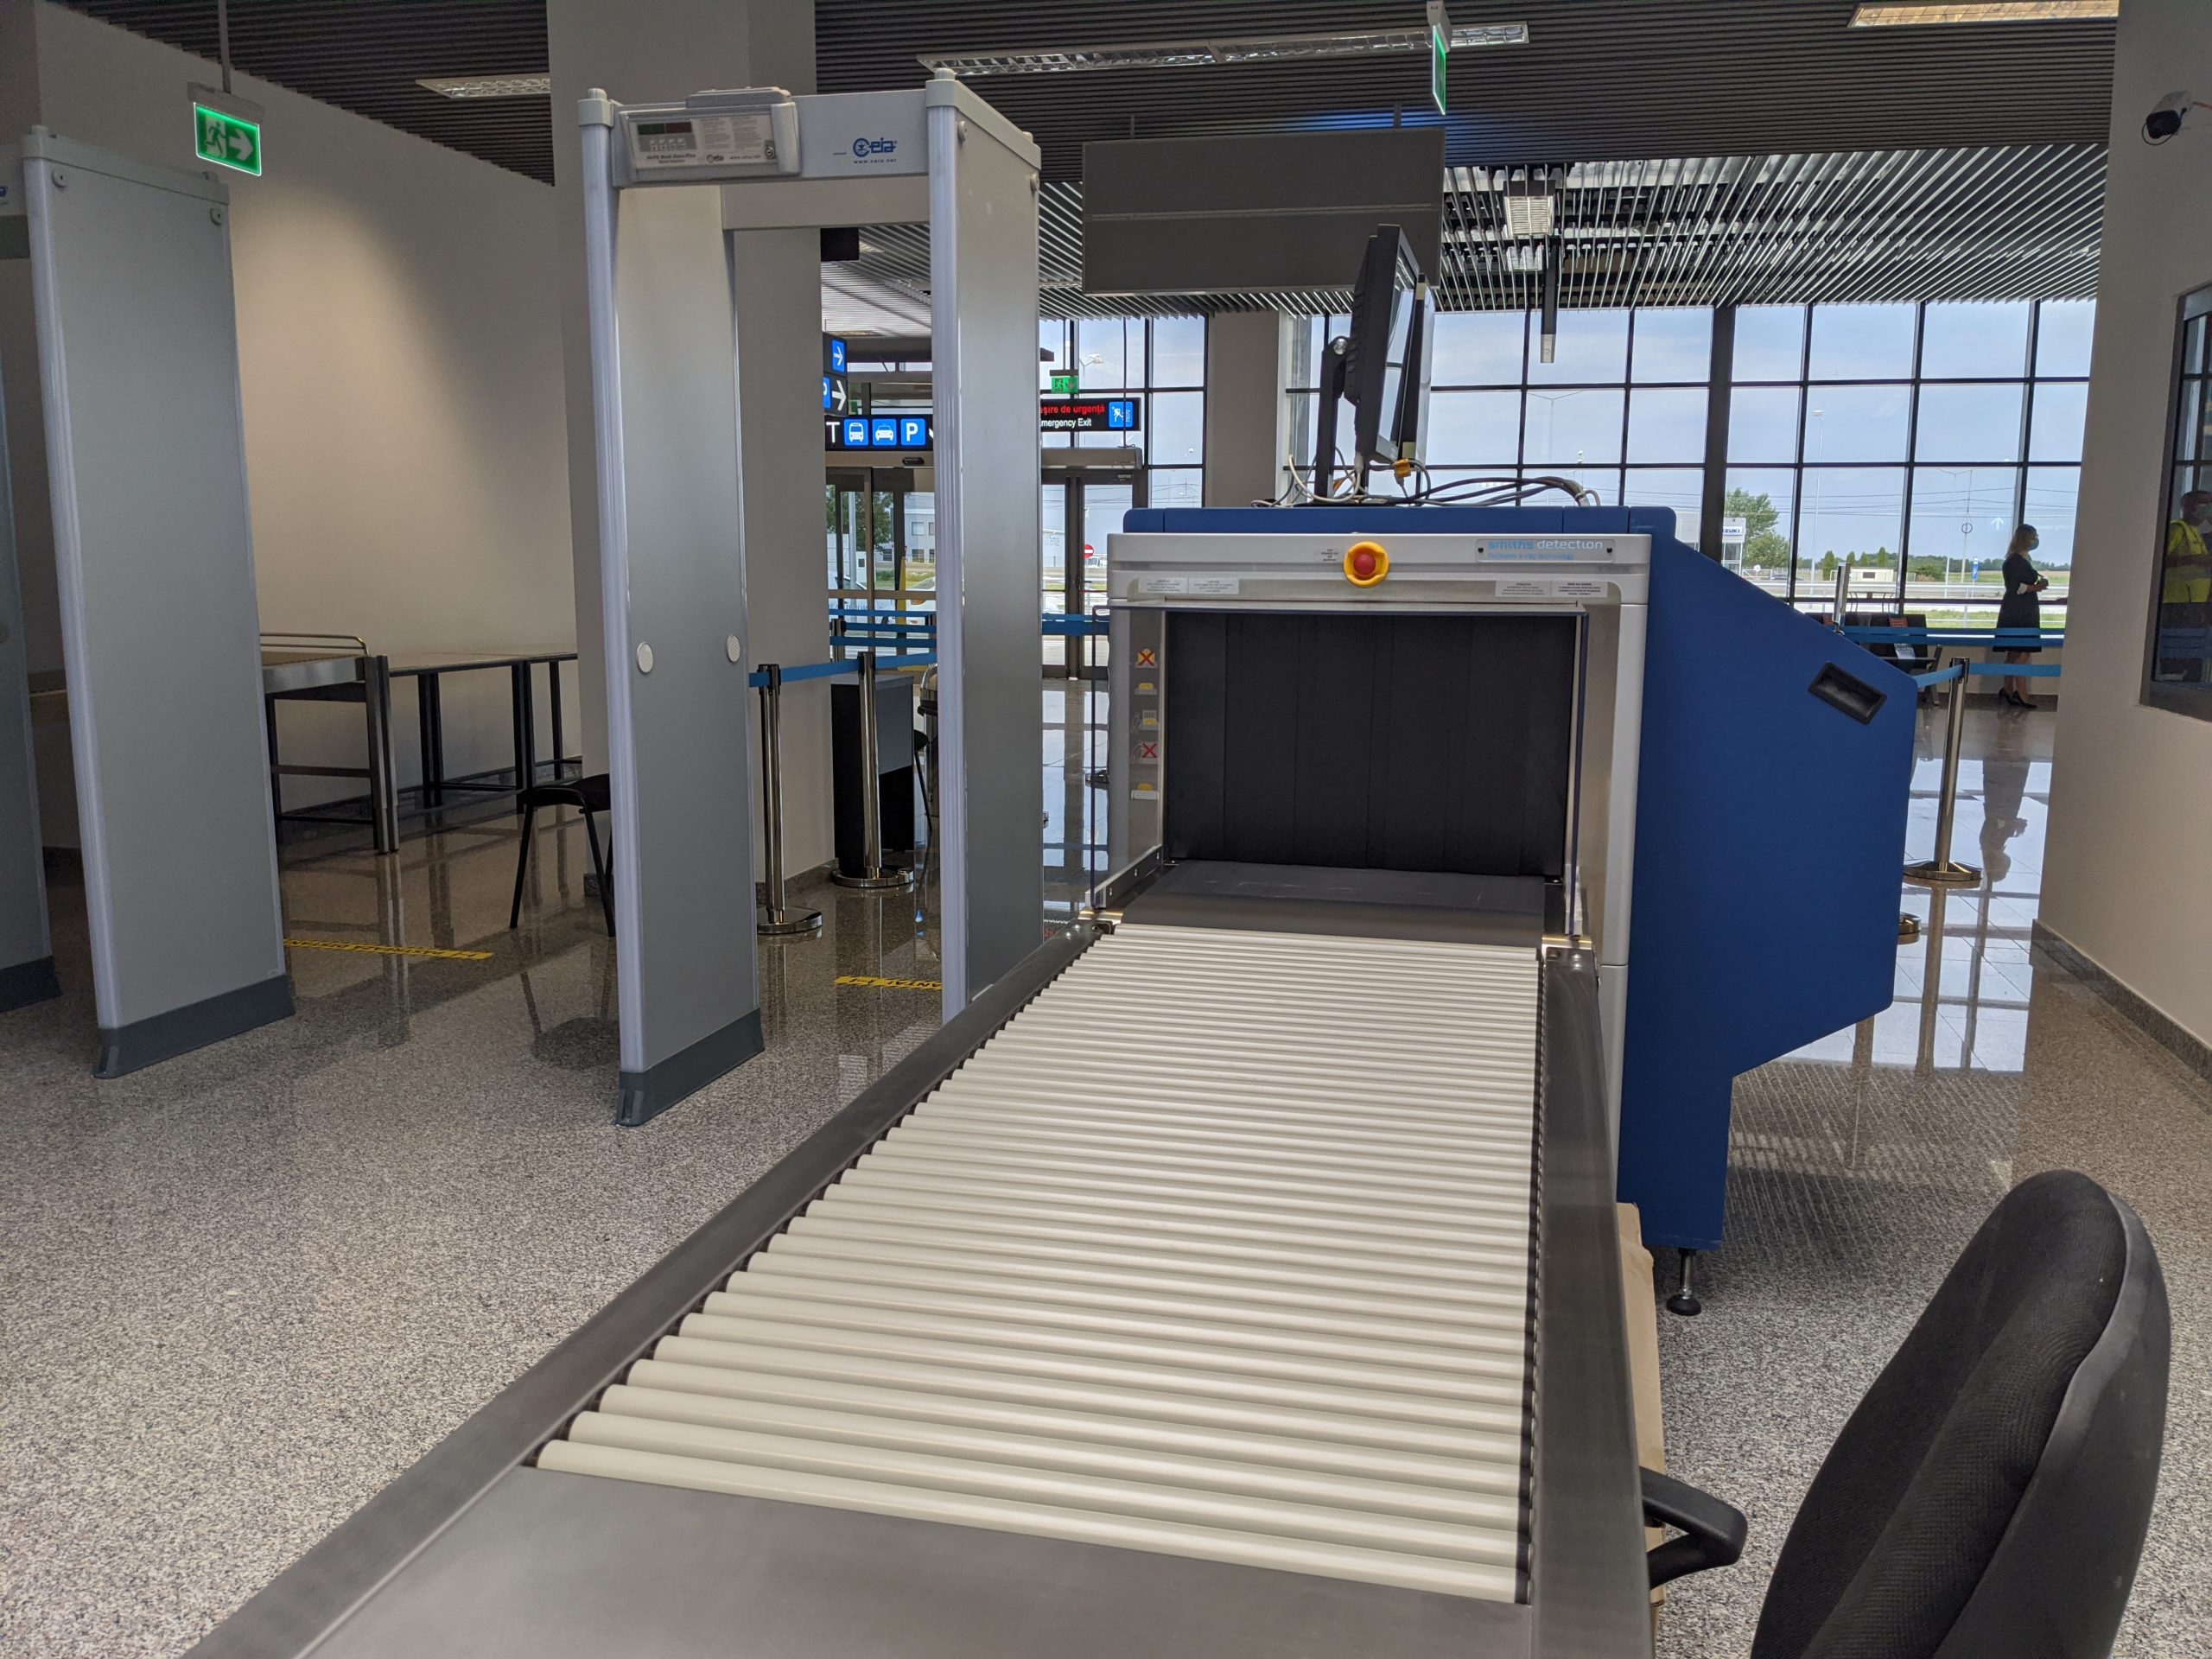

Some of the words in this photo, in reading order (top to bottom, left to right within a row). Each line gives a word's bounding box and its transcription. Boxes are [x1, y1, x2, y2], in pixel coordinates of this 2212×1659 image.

[1060, 404, 1070, 413] de
[1077, 417, 1092, 427] Exit
[906, 422, 918, 442] P
[1487, 540, 1535, 550] smiths
[1536, 539, 1604, 550] detection
